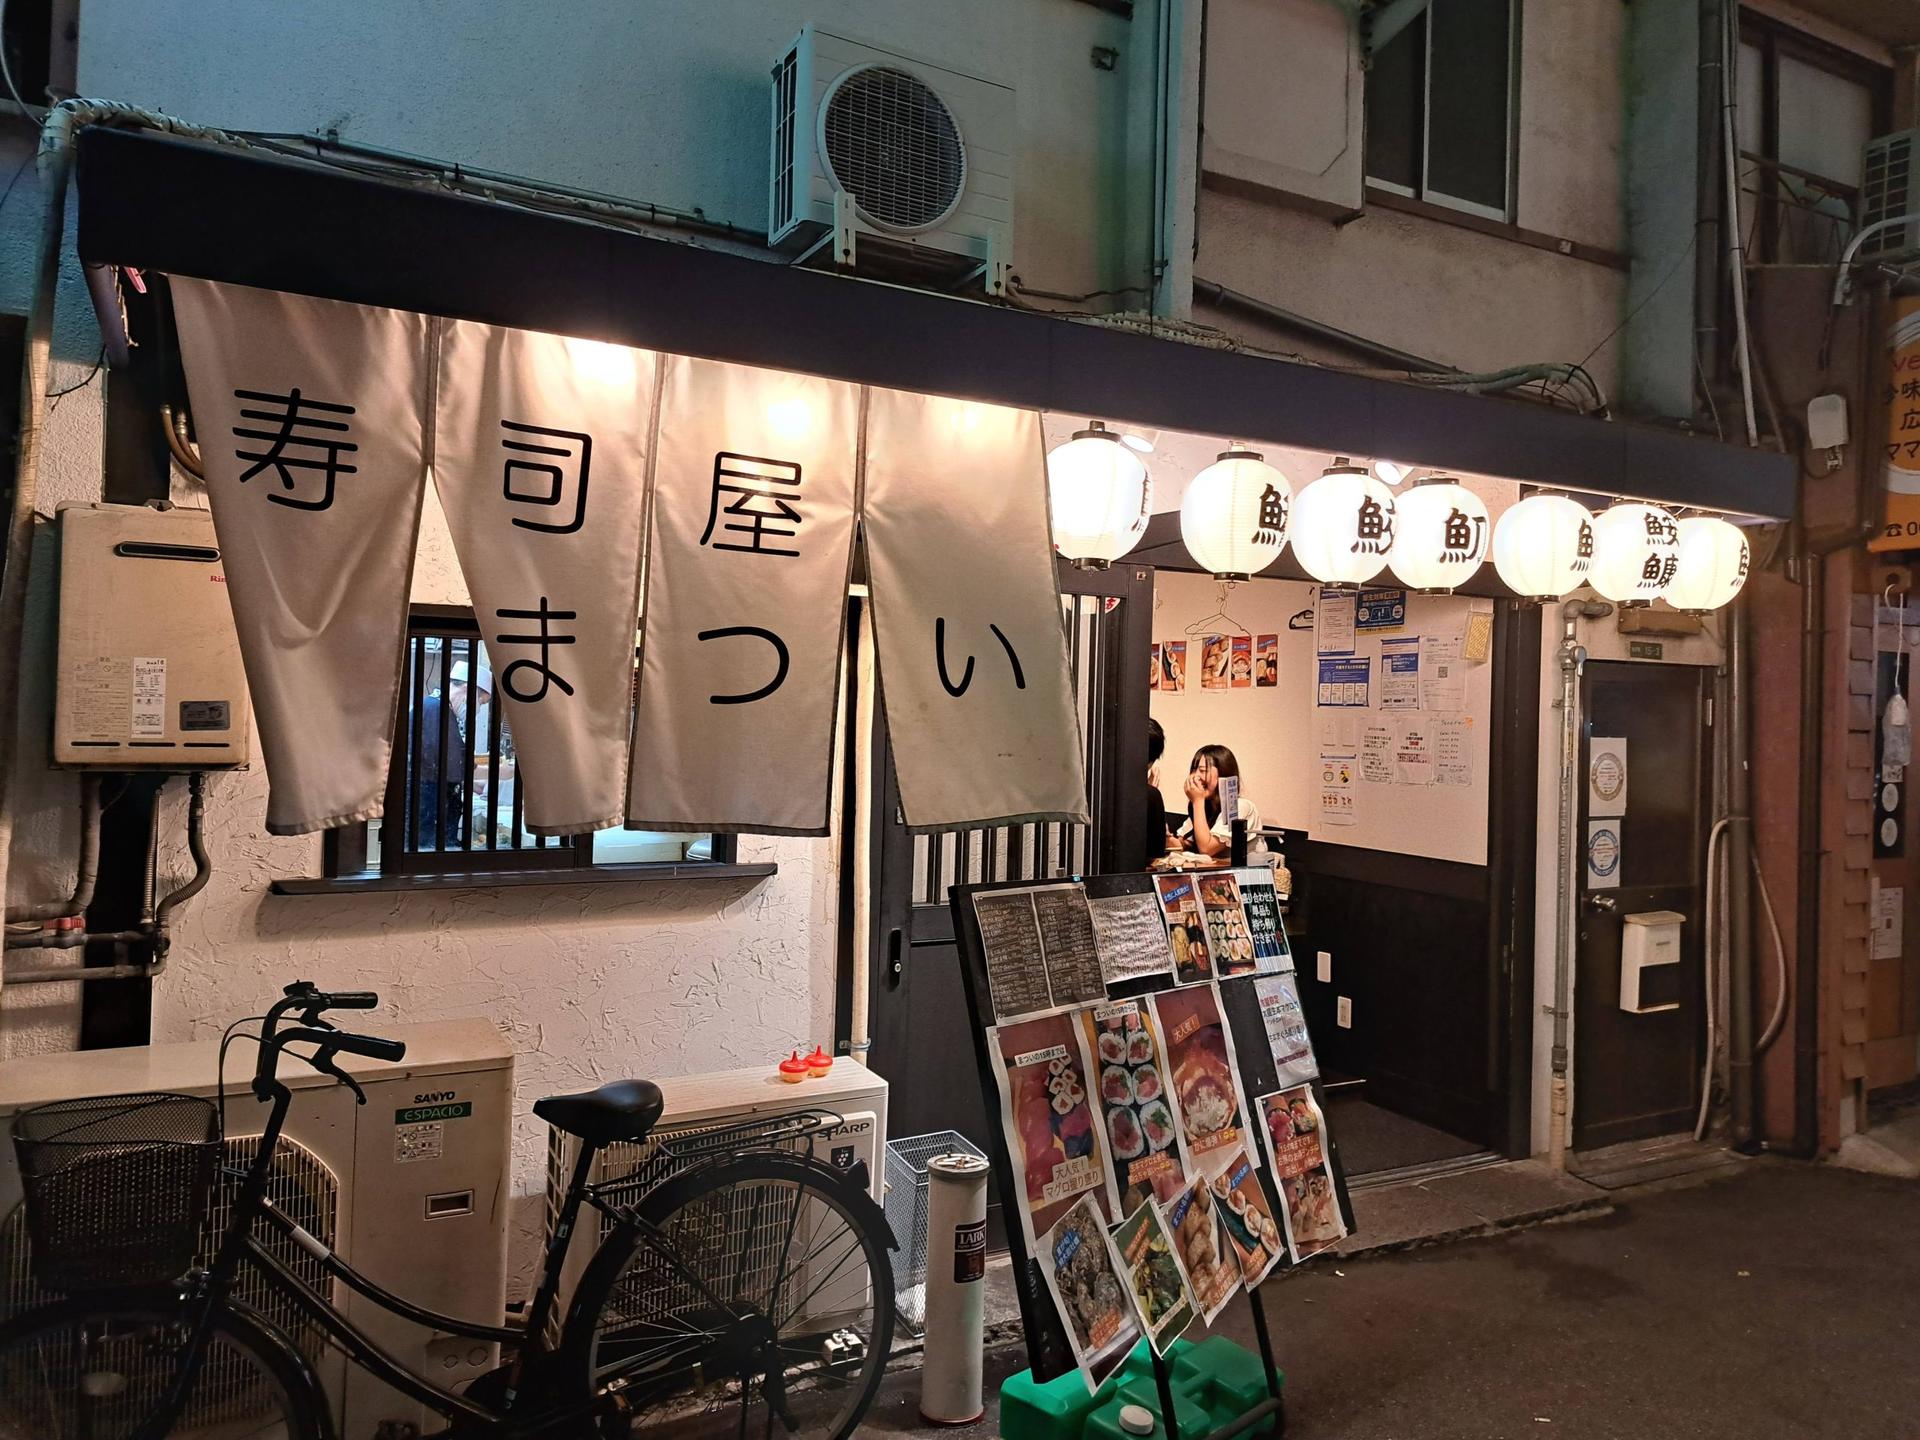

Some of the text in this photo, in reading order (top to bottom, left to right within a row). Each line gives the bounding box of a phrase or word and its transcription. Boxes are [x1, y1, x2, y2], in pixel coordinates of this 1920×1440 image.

[233, 388, 803, 557] 寿司屋
[496, 596, 1026, 704] まつい
[413, 1091, 456, 1104] SANYO
[404, 1105, 464, 1121] ESPACIO
[818, 1122, 870, 1139] SHARP
[960, 1229, 985, 1246] LARK
